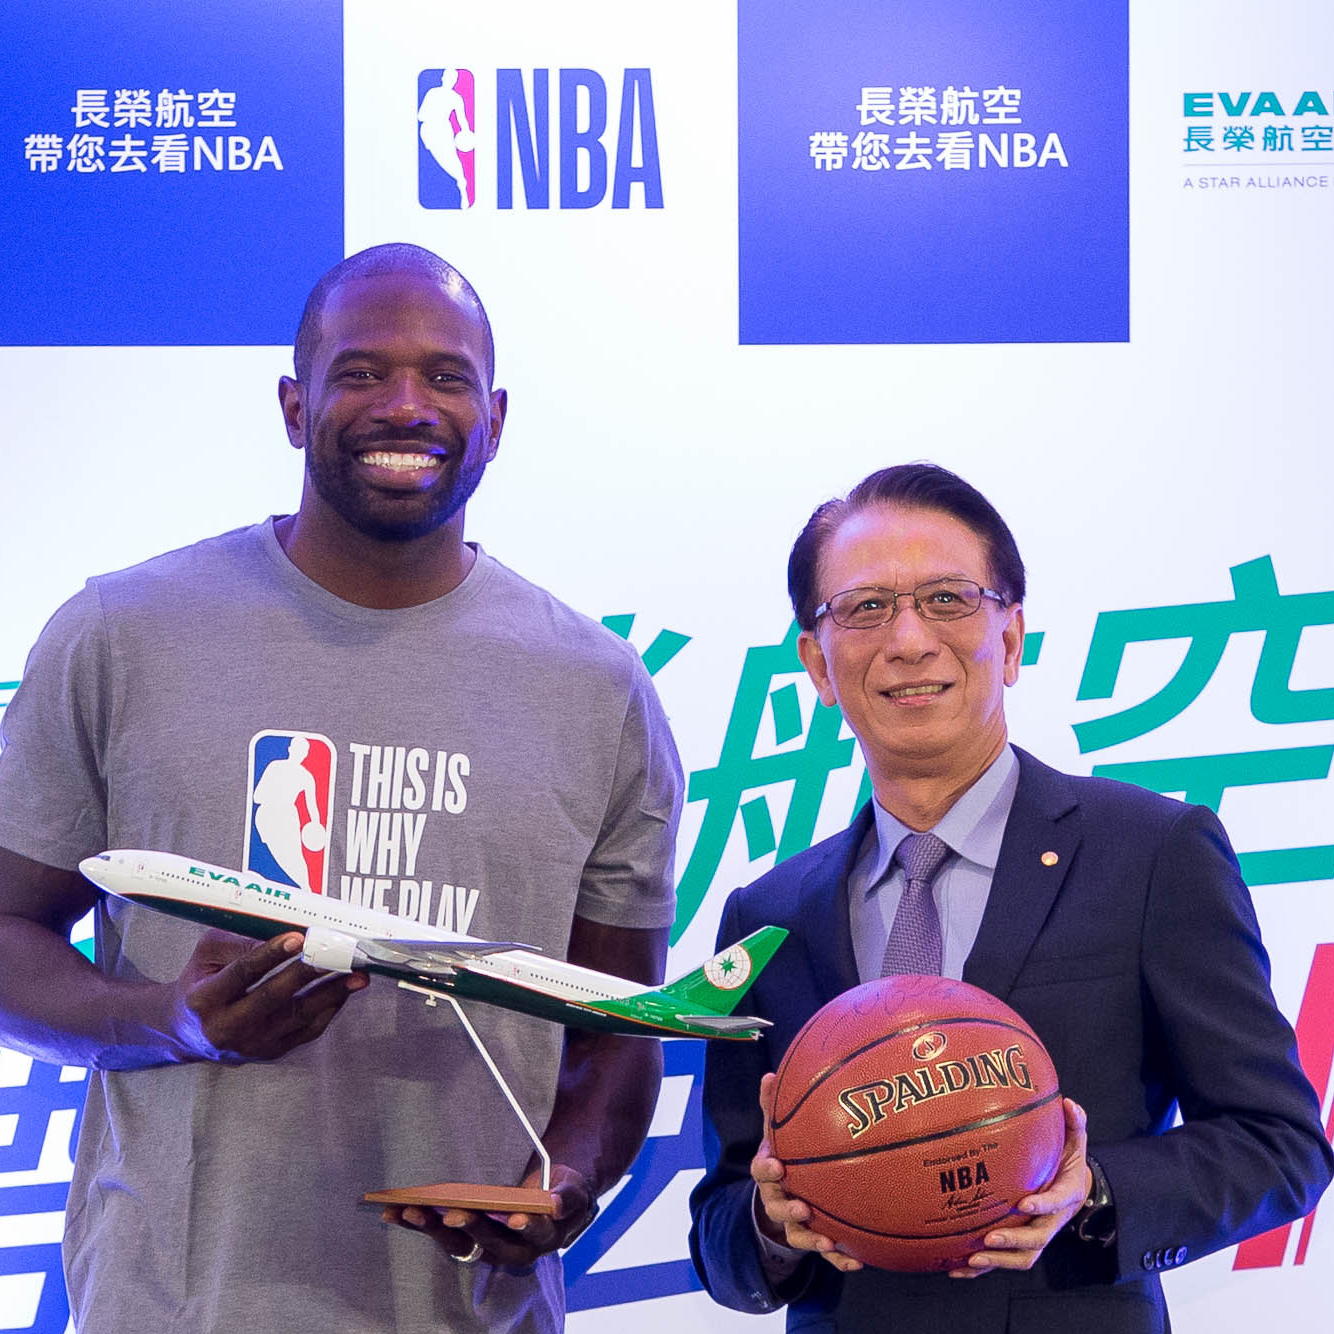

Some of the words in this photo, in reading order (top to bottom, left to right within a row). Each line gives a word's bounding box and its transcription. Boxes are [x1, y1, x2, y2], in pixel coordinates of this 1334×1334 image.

[70, 88, 237, 128] 長榮航空
[856, 85, 1022, 126] 長榮航空
[1183, 91, 1286, 117] EVA
[24, 133, 284, 173] 帶您去看NBA
[496, 67, 665, 210] NBA
[809, 130, 1069, 171] 帶您去看NBA
[1183, 125, 1334, 152] 長榮航空
[1183, 177, 1194, 189] A
[1198, 177, 1241, 189] STAR
[1245, 175, 1328, 189] ALLIANCE
[349, 742, 430, 811] THIS
[431, 750, 471, 815] IS
[345, 808, 427, 877] WHY
[189, 865, 240, 888] EVA
[246, 881, 292, 901] AIR
[838, 1043, 1036, 1139] SPALDING
[939, 1160, 990, 1194] NBA
